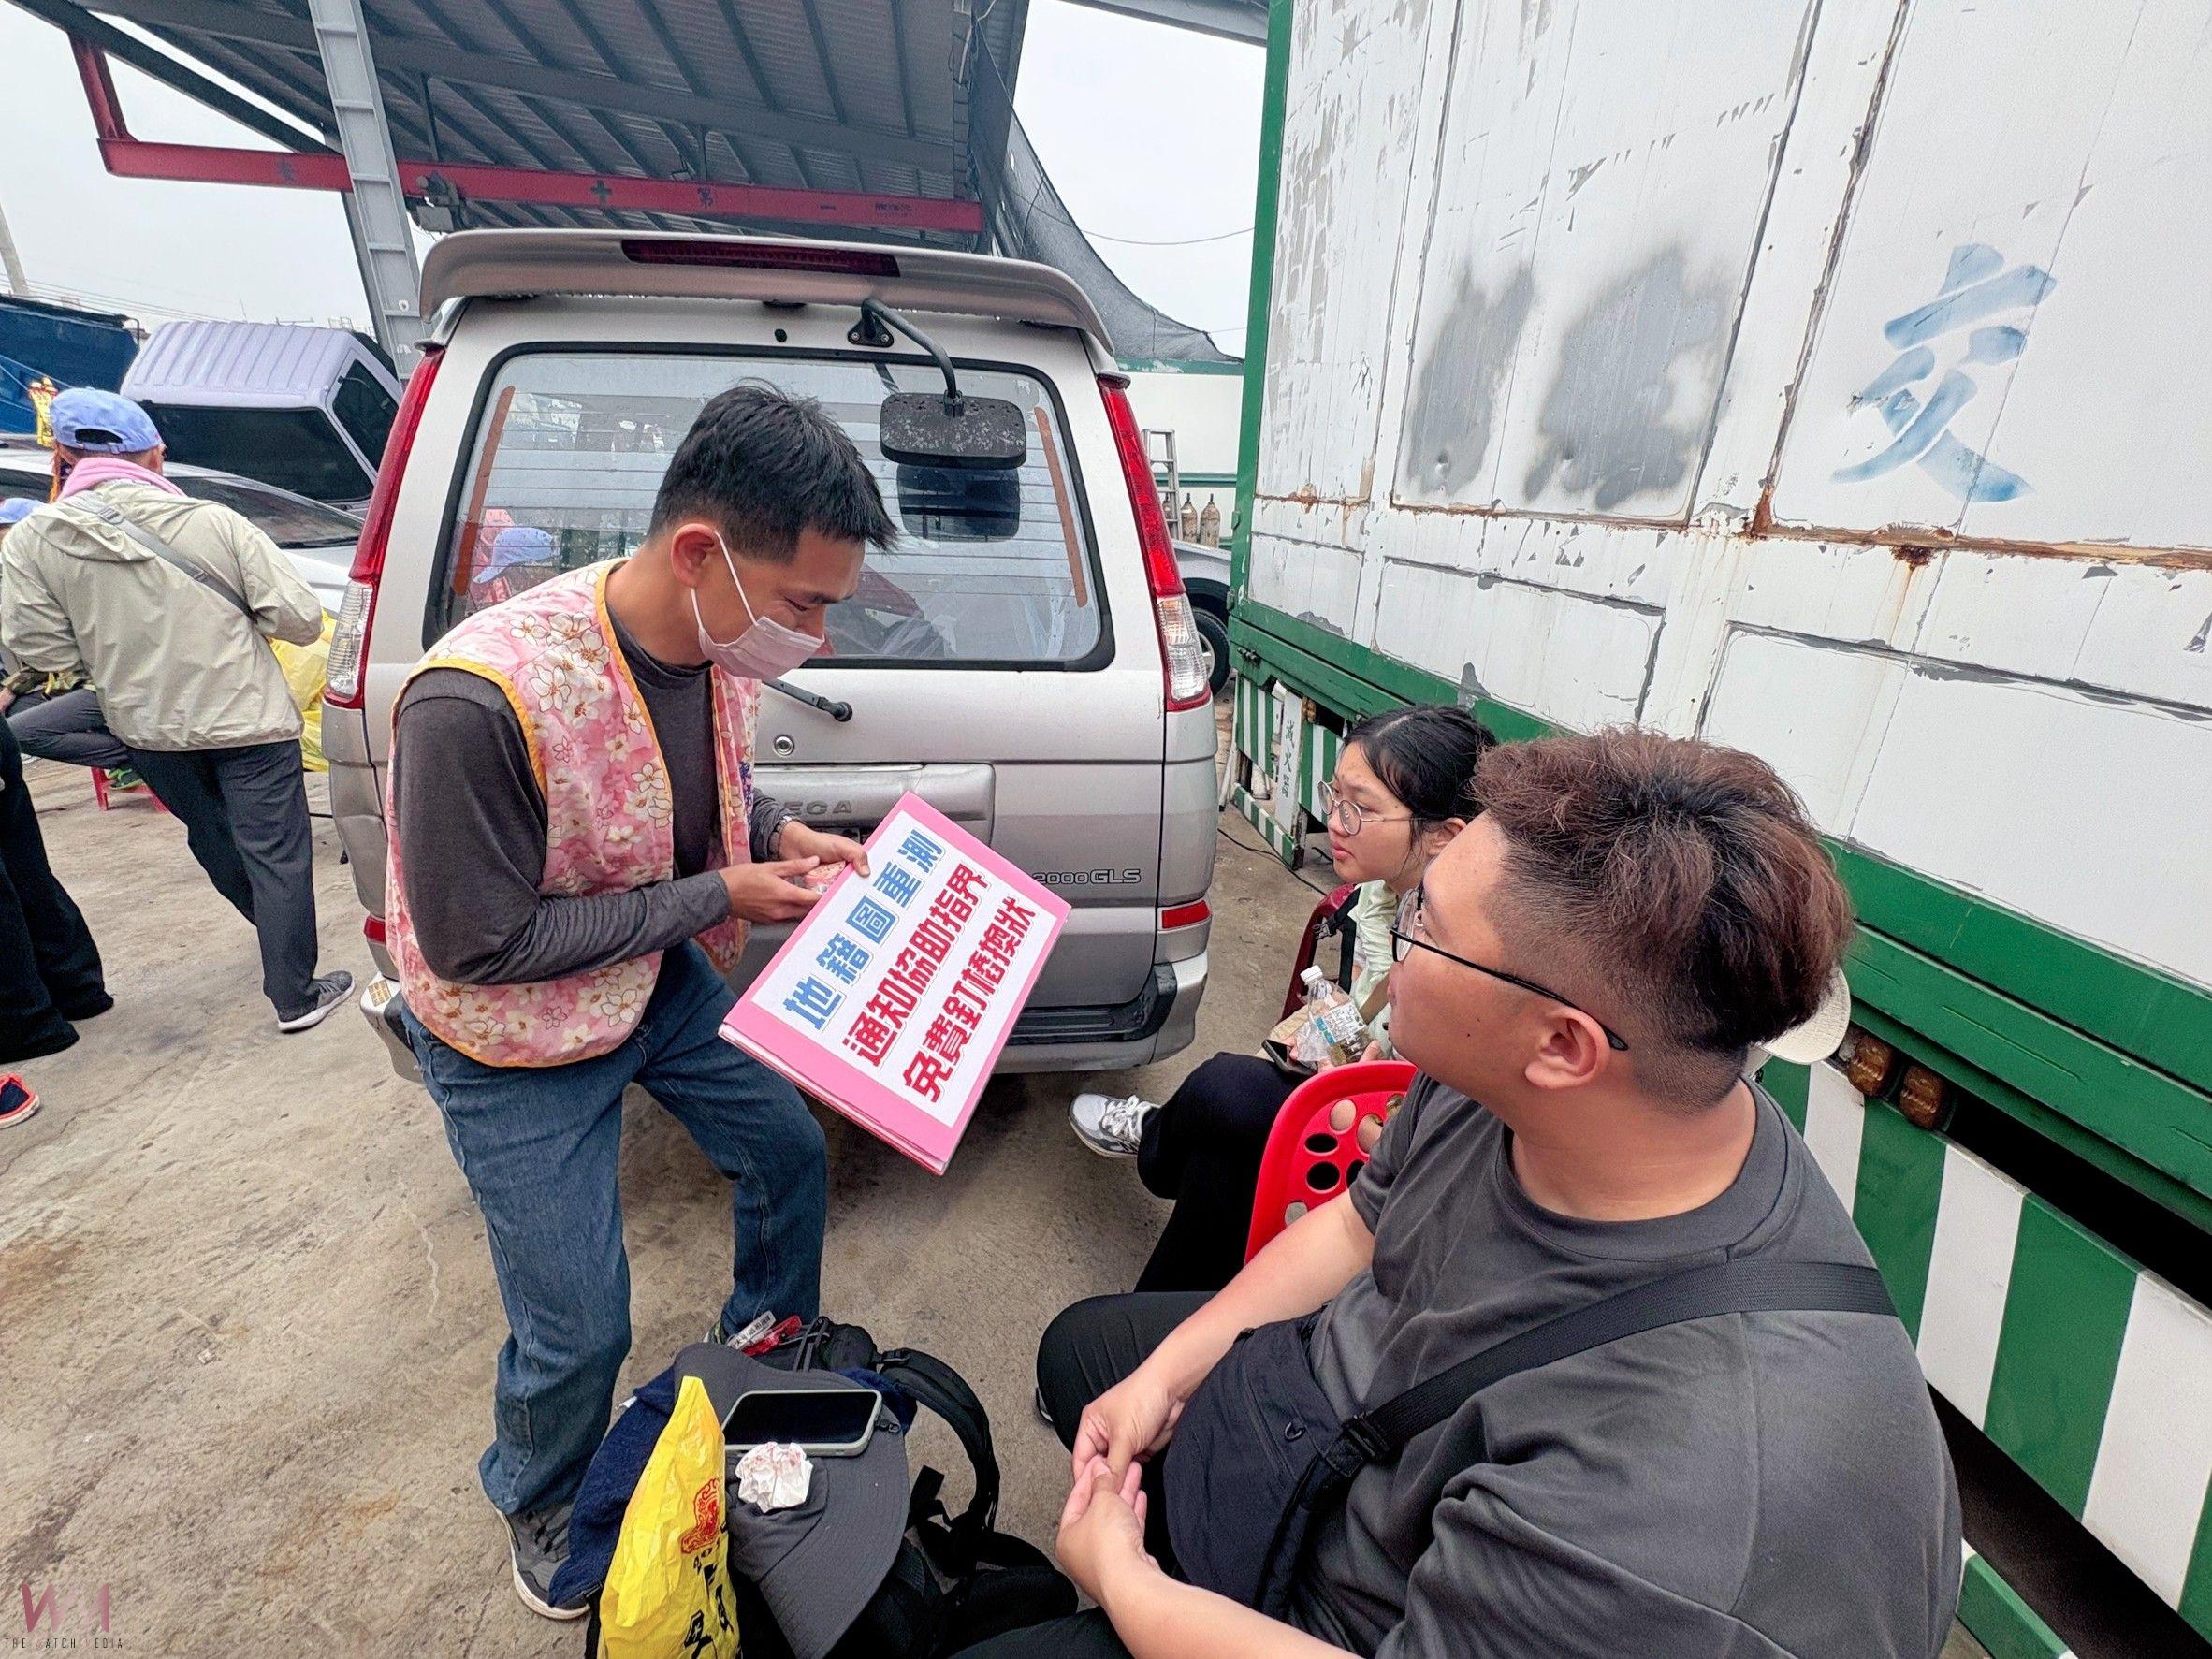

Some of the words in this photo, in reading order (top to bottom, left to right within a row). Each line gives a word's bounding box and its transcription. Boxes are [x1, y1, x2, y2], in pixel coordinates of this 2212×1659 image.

[1831, 243, 2058, 503] 交
[783, 829, 944, 1030] 地籍圖重測
[843, 863, 990, 1066] 通知協助指界
[903, 896, 1036, 1102] 免費釘樁換狀
